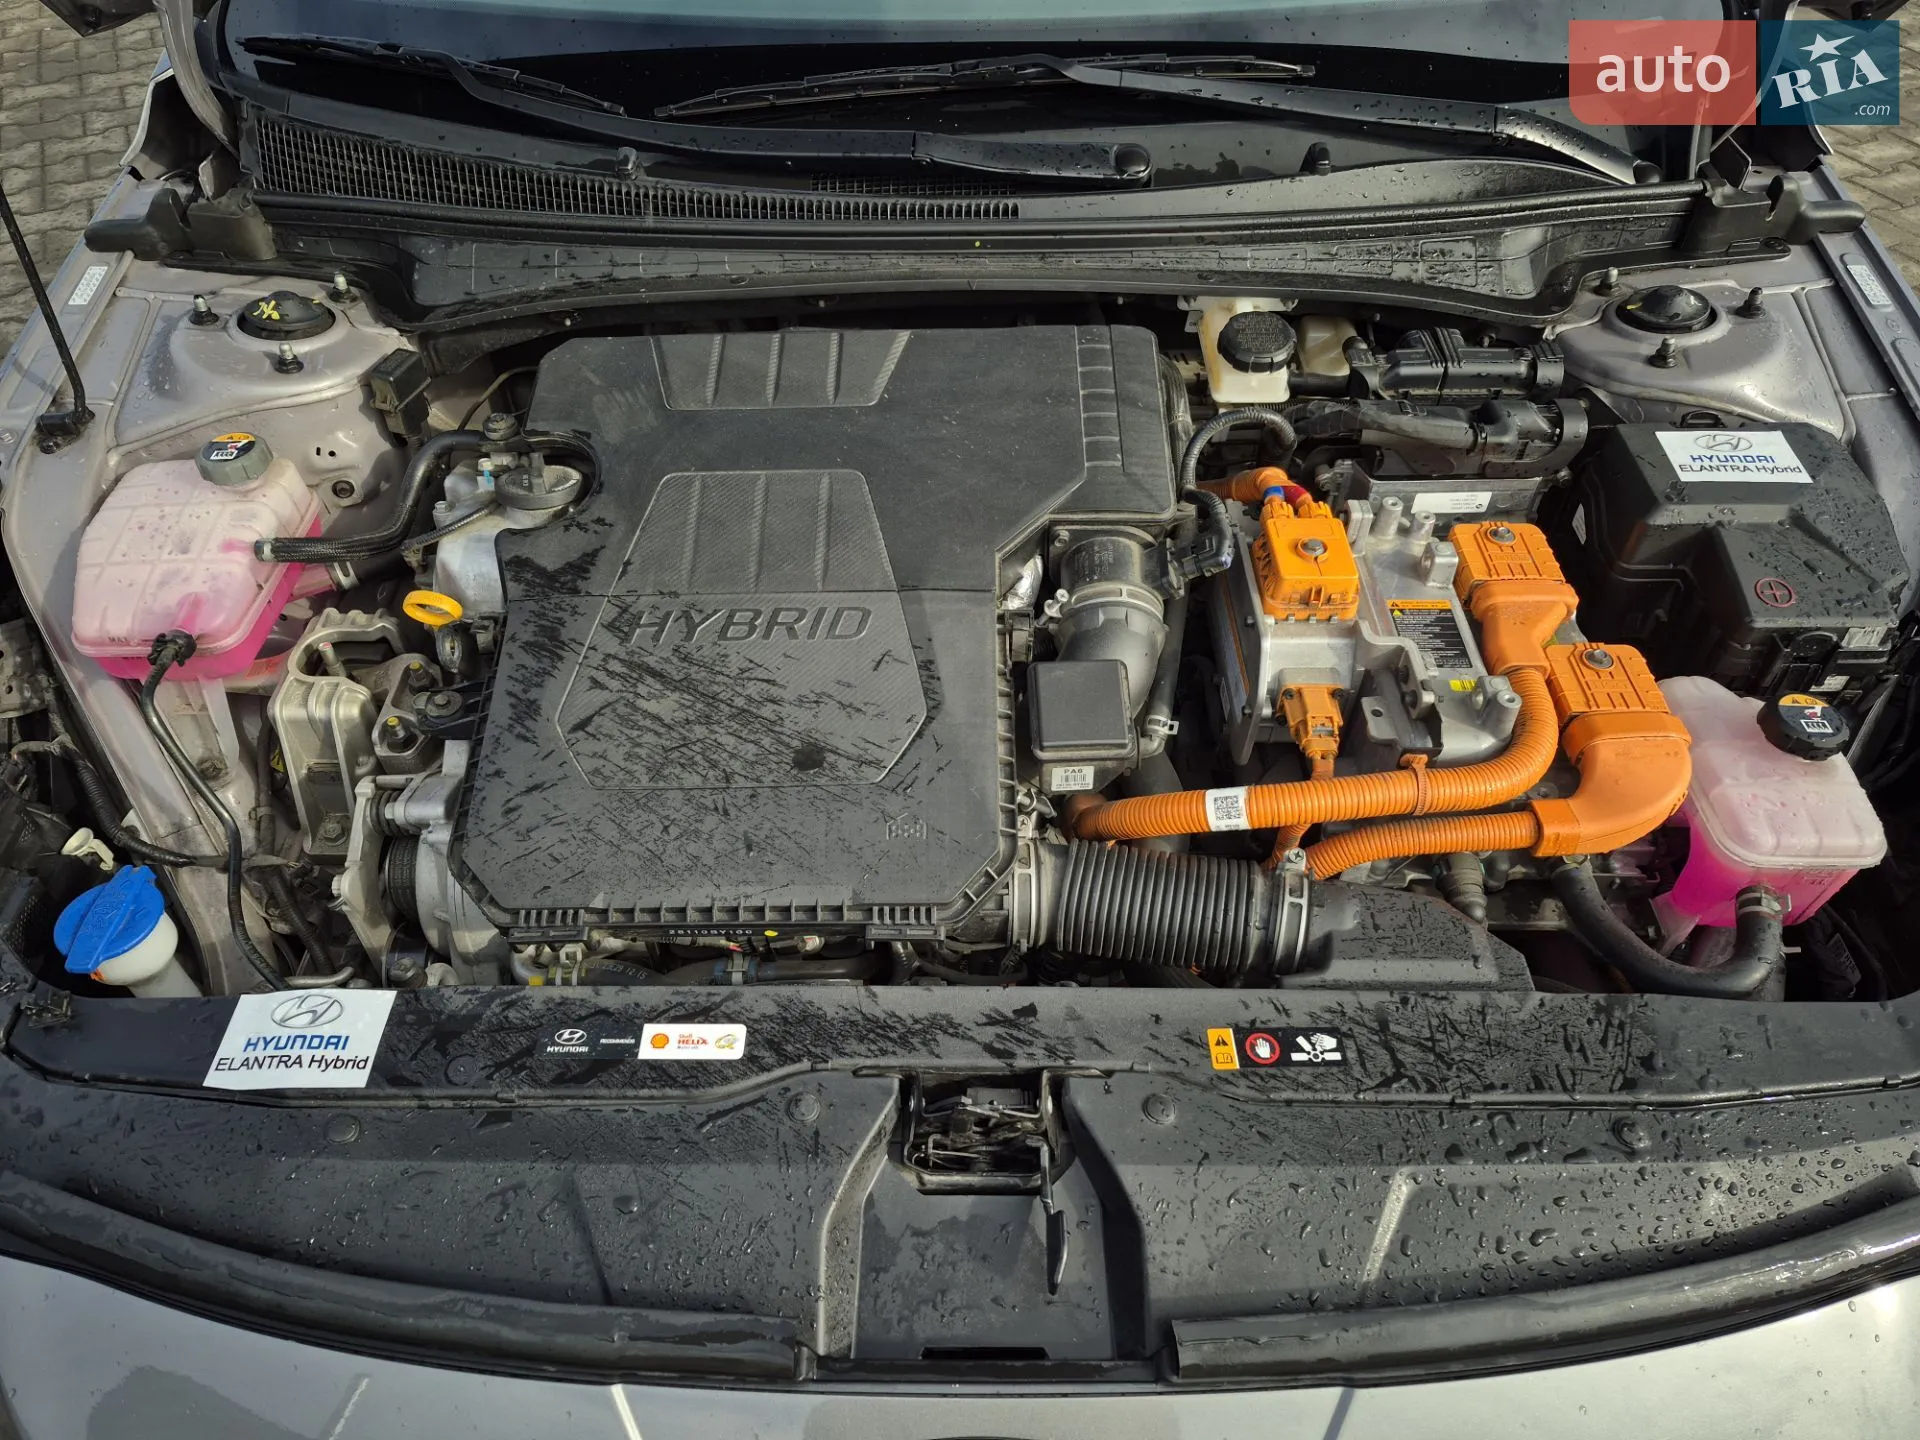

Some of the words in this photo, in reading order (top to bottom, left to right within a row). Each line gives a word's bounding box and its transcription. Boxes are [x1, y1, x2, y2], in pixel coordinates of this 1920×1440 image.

[1690, 454, 1776, 464] HYUNDAI
[1678, 464, 1753, 473] ELANTRA
[1755, 465, 1802, 475] Hybrid
[623, 606, 873, 645] HYBRID
[242, 1034, 350, 1053] HYUNDAI
[678, 1037, 709, 1045] HELIX
[546, 1045, 589, 1053] HYUNDAI
[214, 1054, 303, 1071] ELANTRA
[307, 1054, 370, 1073] Hybrid
